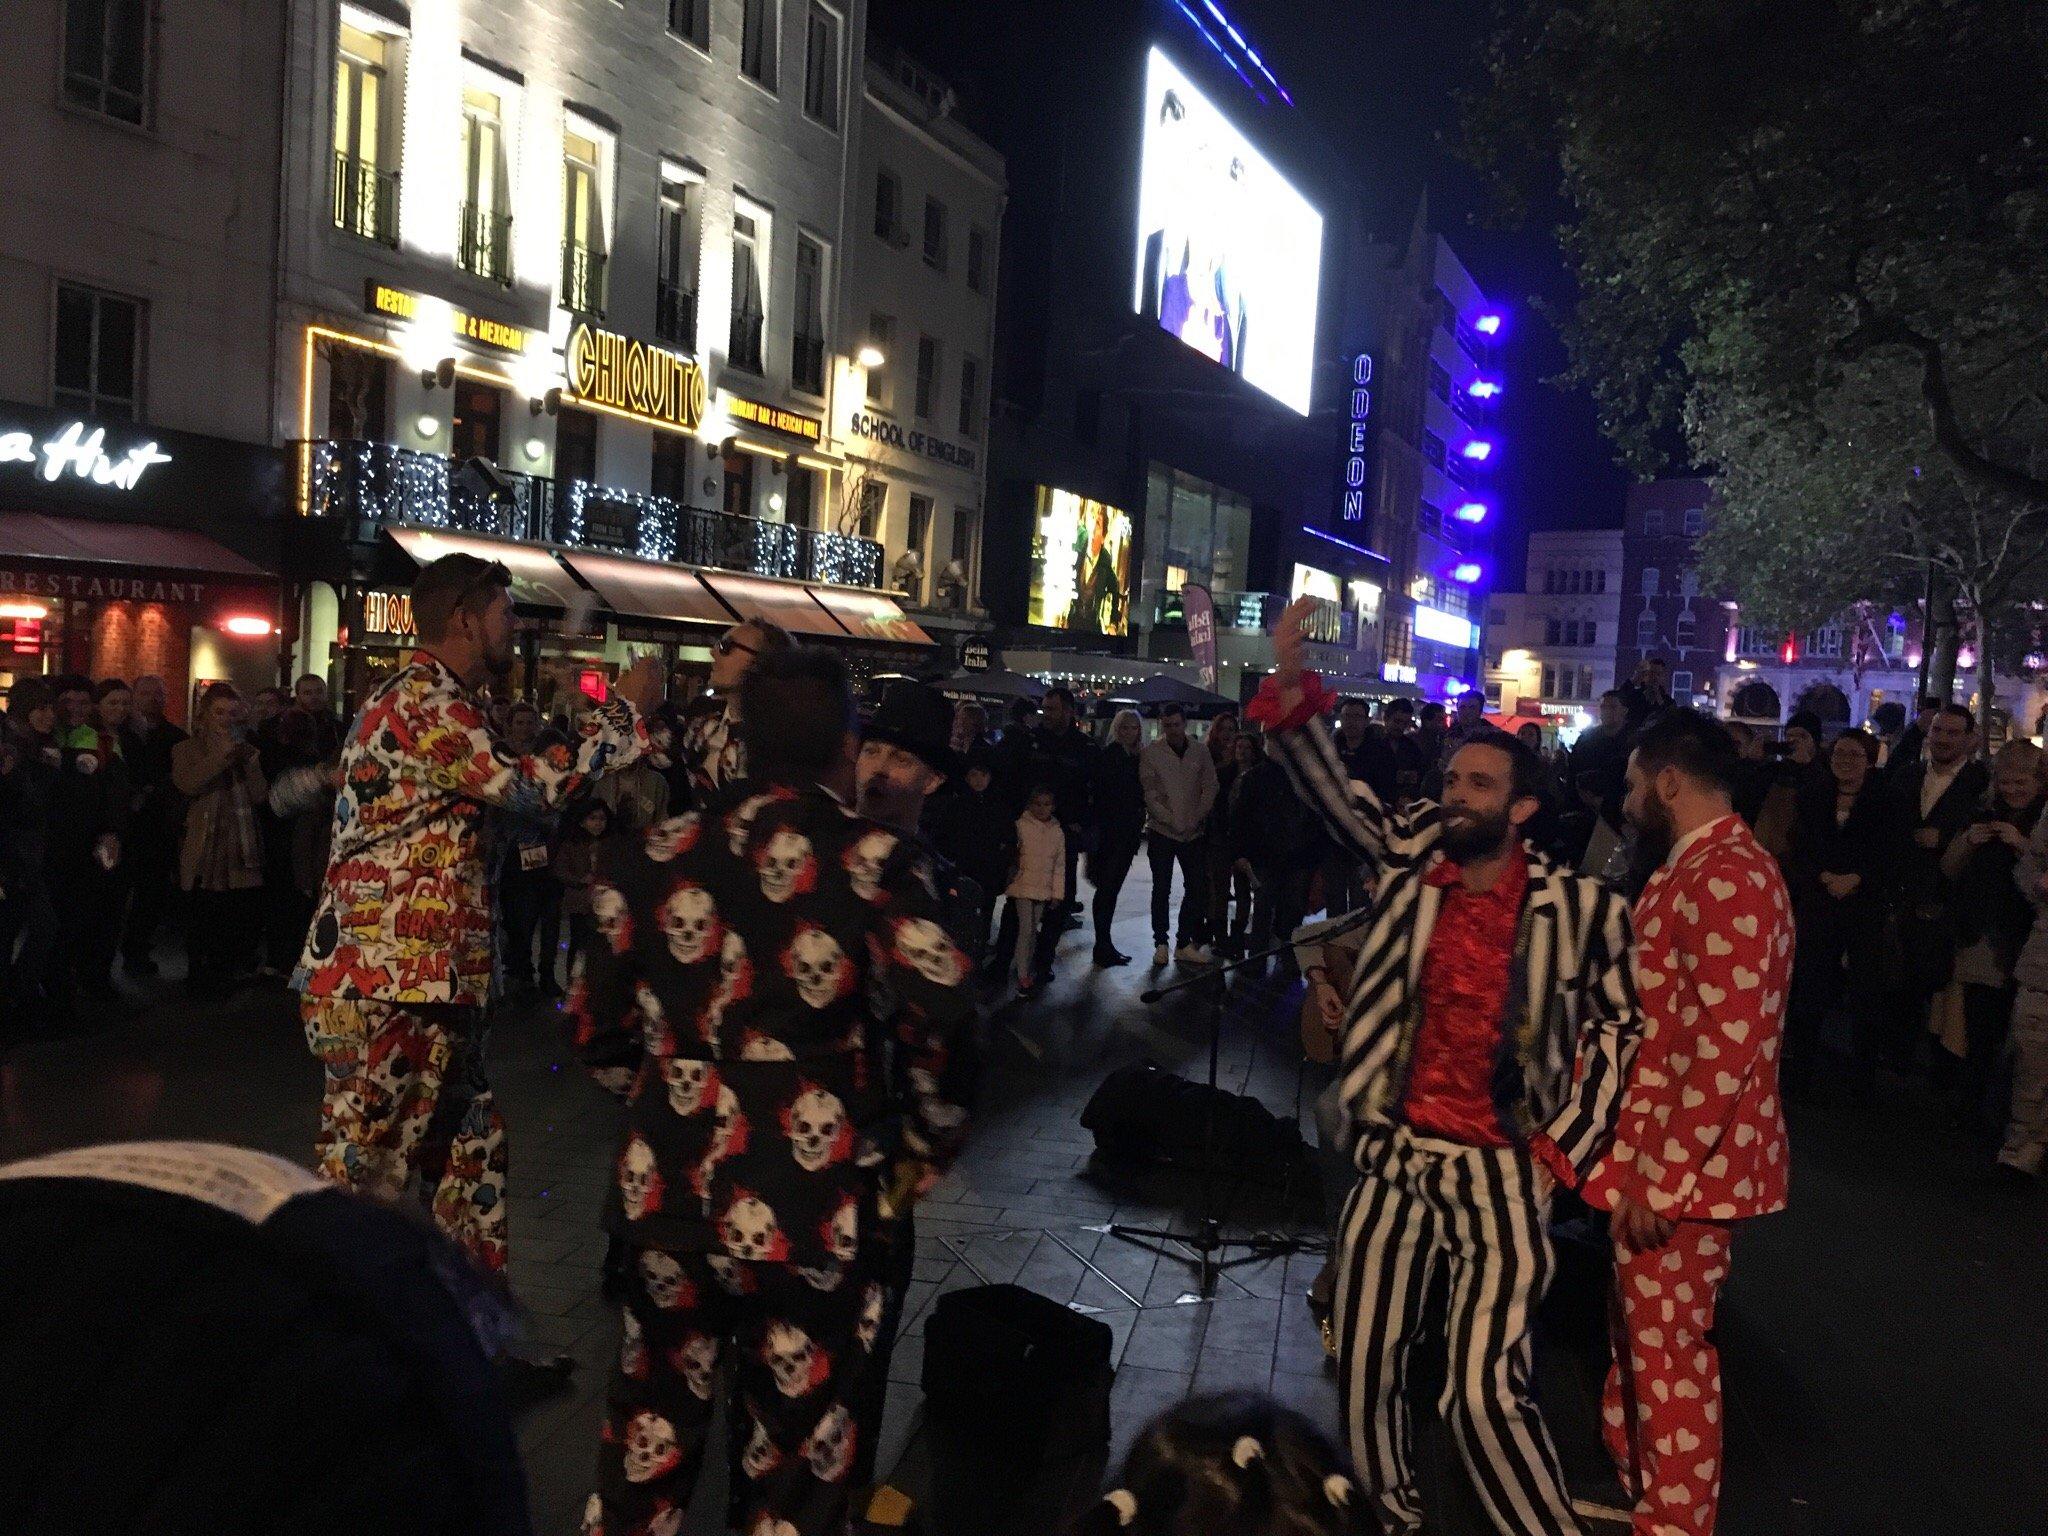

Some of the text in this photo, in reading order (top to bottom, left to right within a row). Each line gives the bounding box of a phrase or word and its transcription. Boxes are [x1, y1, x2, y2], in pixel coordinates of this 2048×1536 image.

[479, 318, 522, 351] MEXICAN
[576, 323, 706, 429] CHIQUITO
[758, 406, 770, 425] BAR
[777, 411, 803, 435] MEXICAN
[850, 412, 977, 470] SCHOOL OF ENGLISH
[1344, 354, 1371, 521] ODEON
[42, 421, 173, 491] Hut
[1, 571, 206, 602] RESTAURANT
